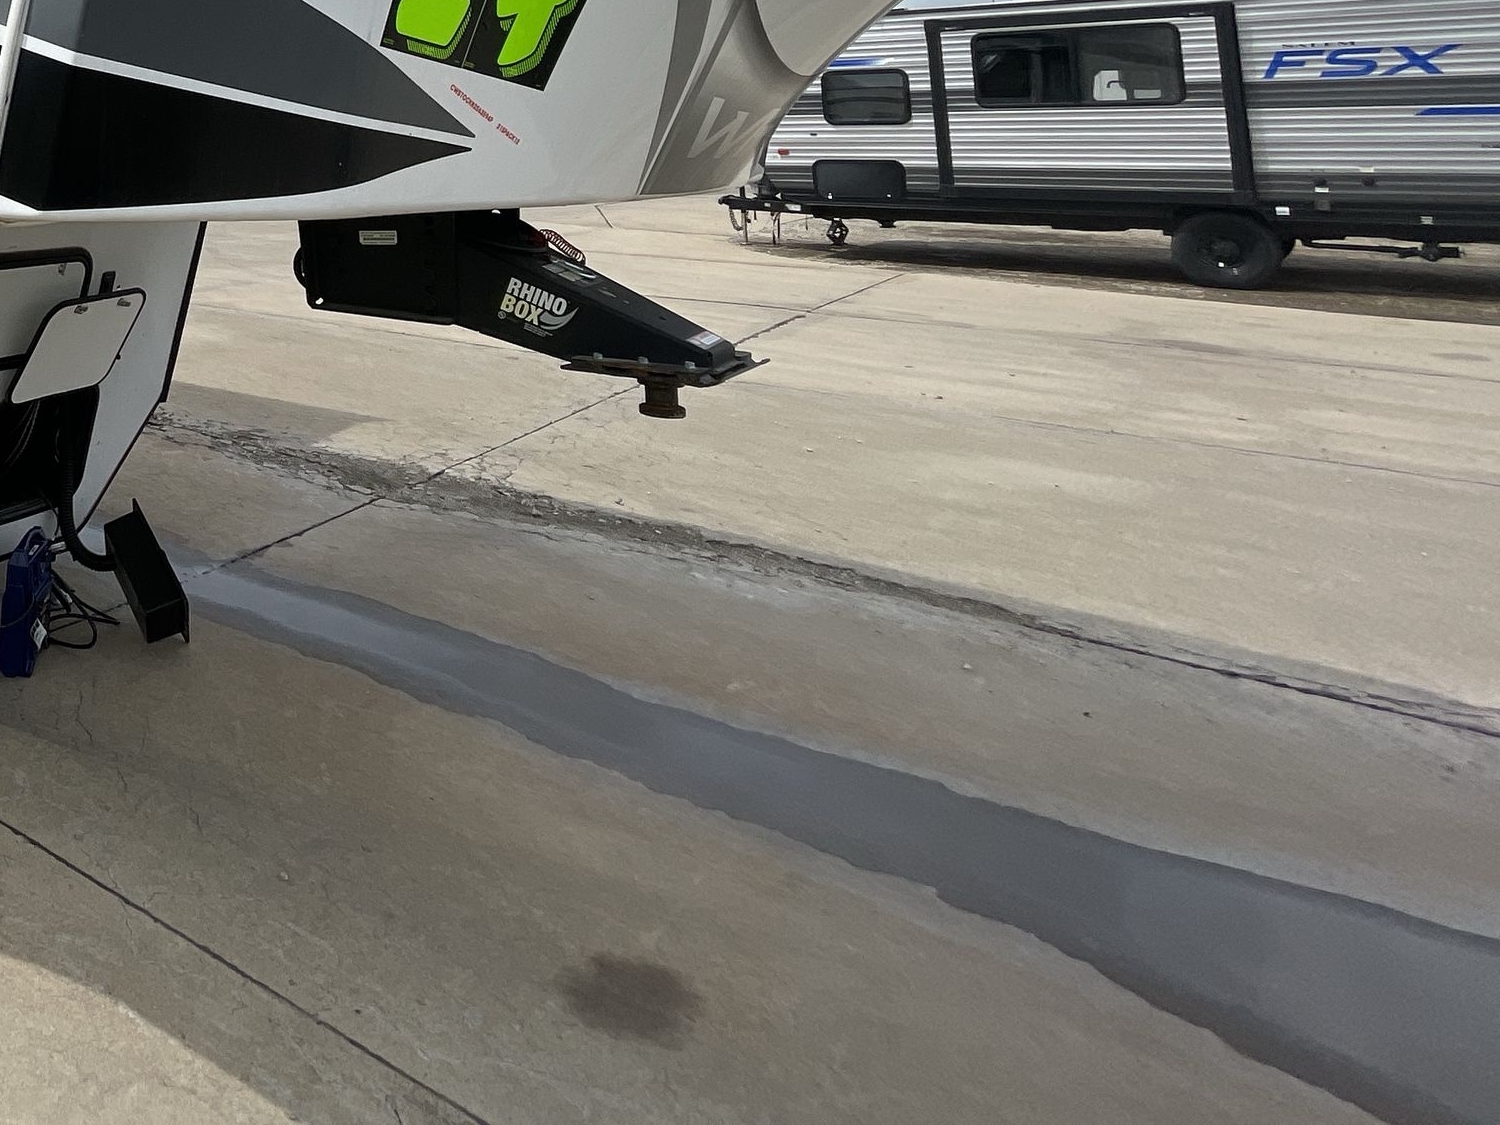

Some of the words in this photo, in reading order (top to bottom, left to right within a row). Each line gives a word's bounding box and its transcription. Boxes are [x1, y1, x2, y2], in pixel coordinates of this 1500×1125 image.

[1263, 43, 1465, 79] FSX
[500, 293, 544, 326] BOX
[506, 276, 568, 316] RHINO
